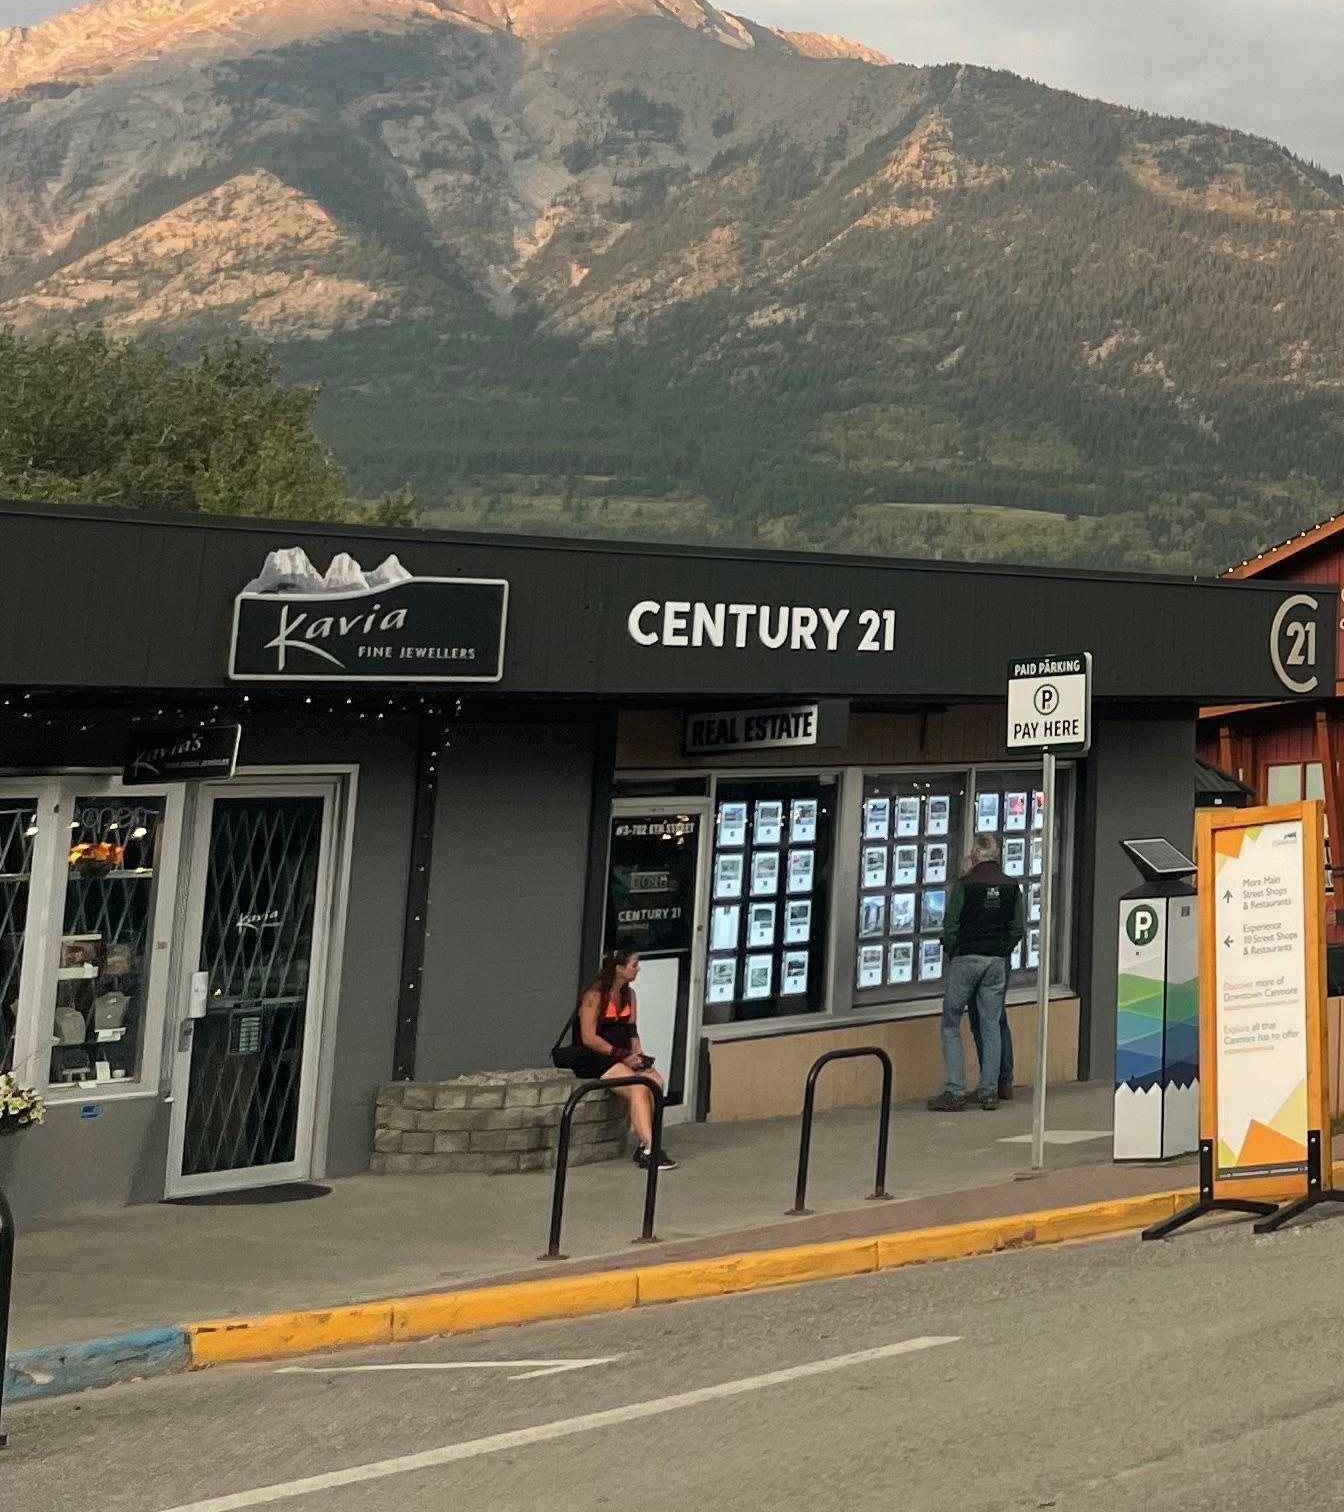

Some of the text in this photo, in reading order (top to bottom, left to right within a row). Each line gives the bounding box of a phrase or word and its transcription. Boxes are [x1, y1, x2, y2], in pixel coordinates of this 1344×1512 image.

[628, 600, 896, 651] CENTURY 21
[264, 604, 408, 671] Kavia
[358, 646, 476, 659] FINE JEWELLERS
[1014, 659, 1080, 676] PAID PARKING
[1042, 689, 1053, 710] P
[692, 712, 814, 746] REAL ESTATE
[1014, 719, 1079, 740] PAY HERE
[1242, 875, 1281, 888] More Main
[1242, 887, 1288, 900] Street Shops
[1250, 898, 1292, 909] Restaurants
[618, 908, 682, 922] CENTURY 21
[1135, 910, 1153, 940] P
[1242, 922, 1282, 934] Experience
[1253, 933, 1275, 944] Street
[1276, 930, 1298, 941] Shops
[1250, 944, 1292, 954] Restaurants
